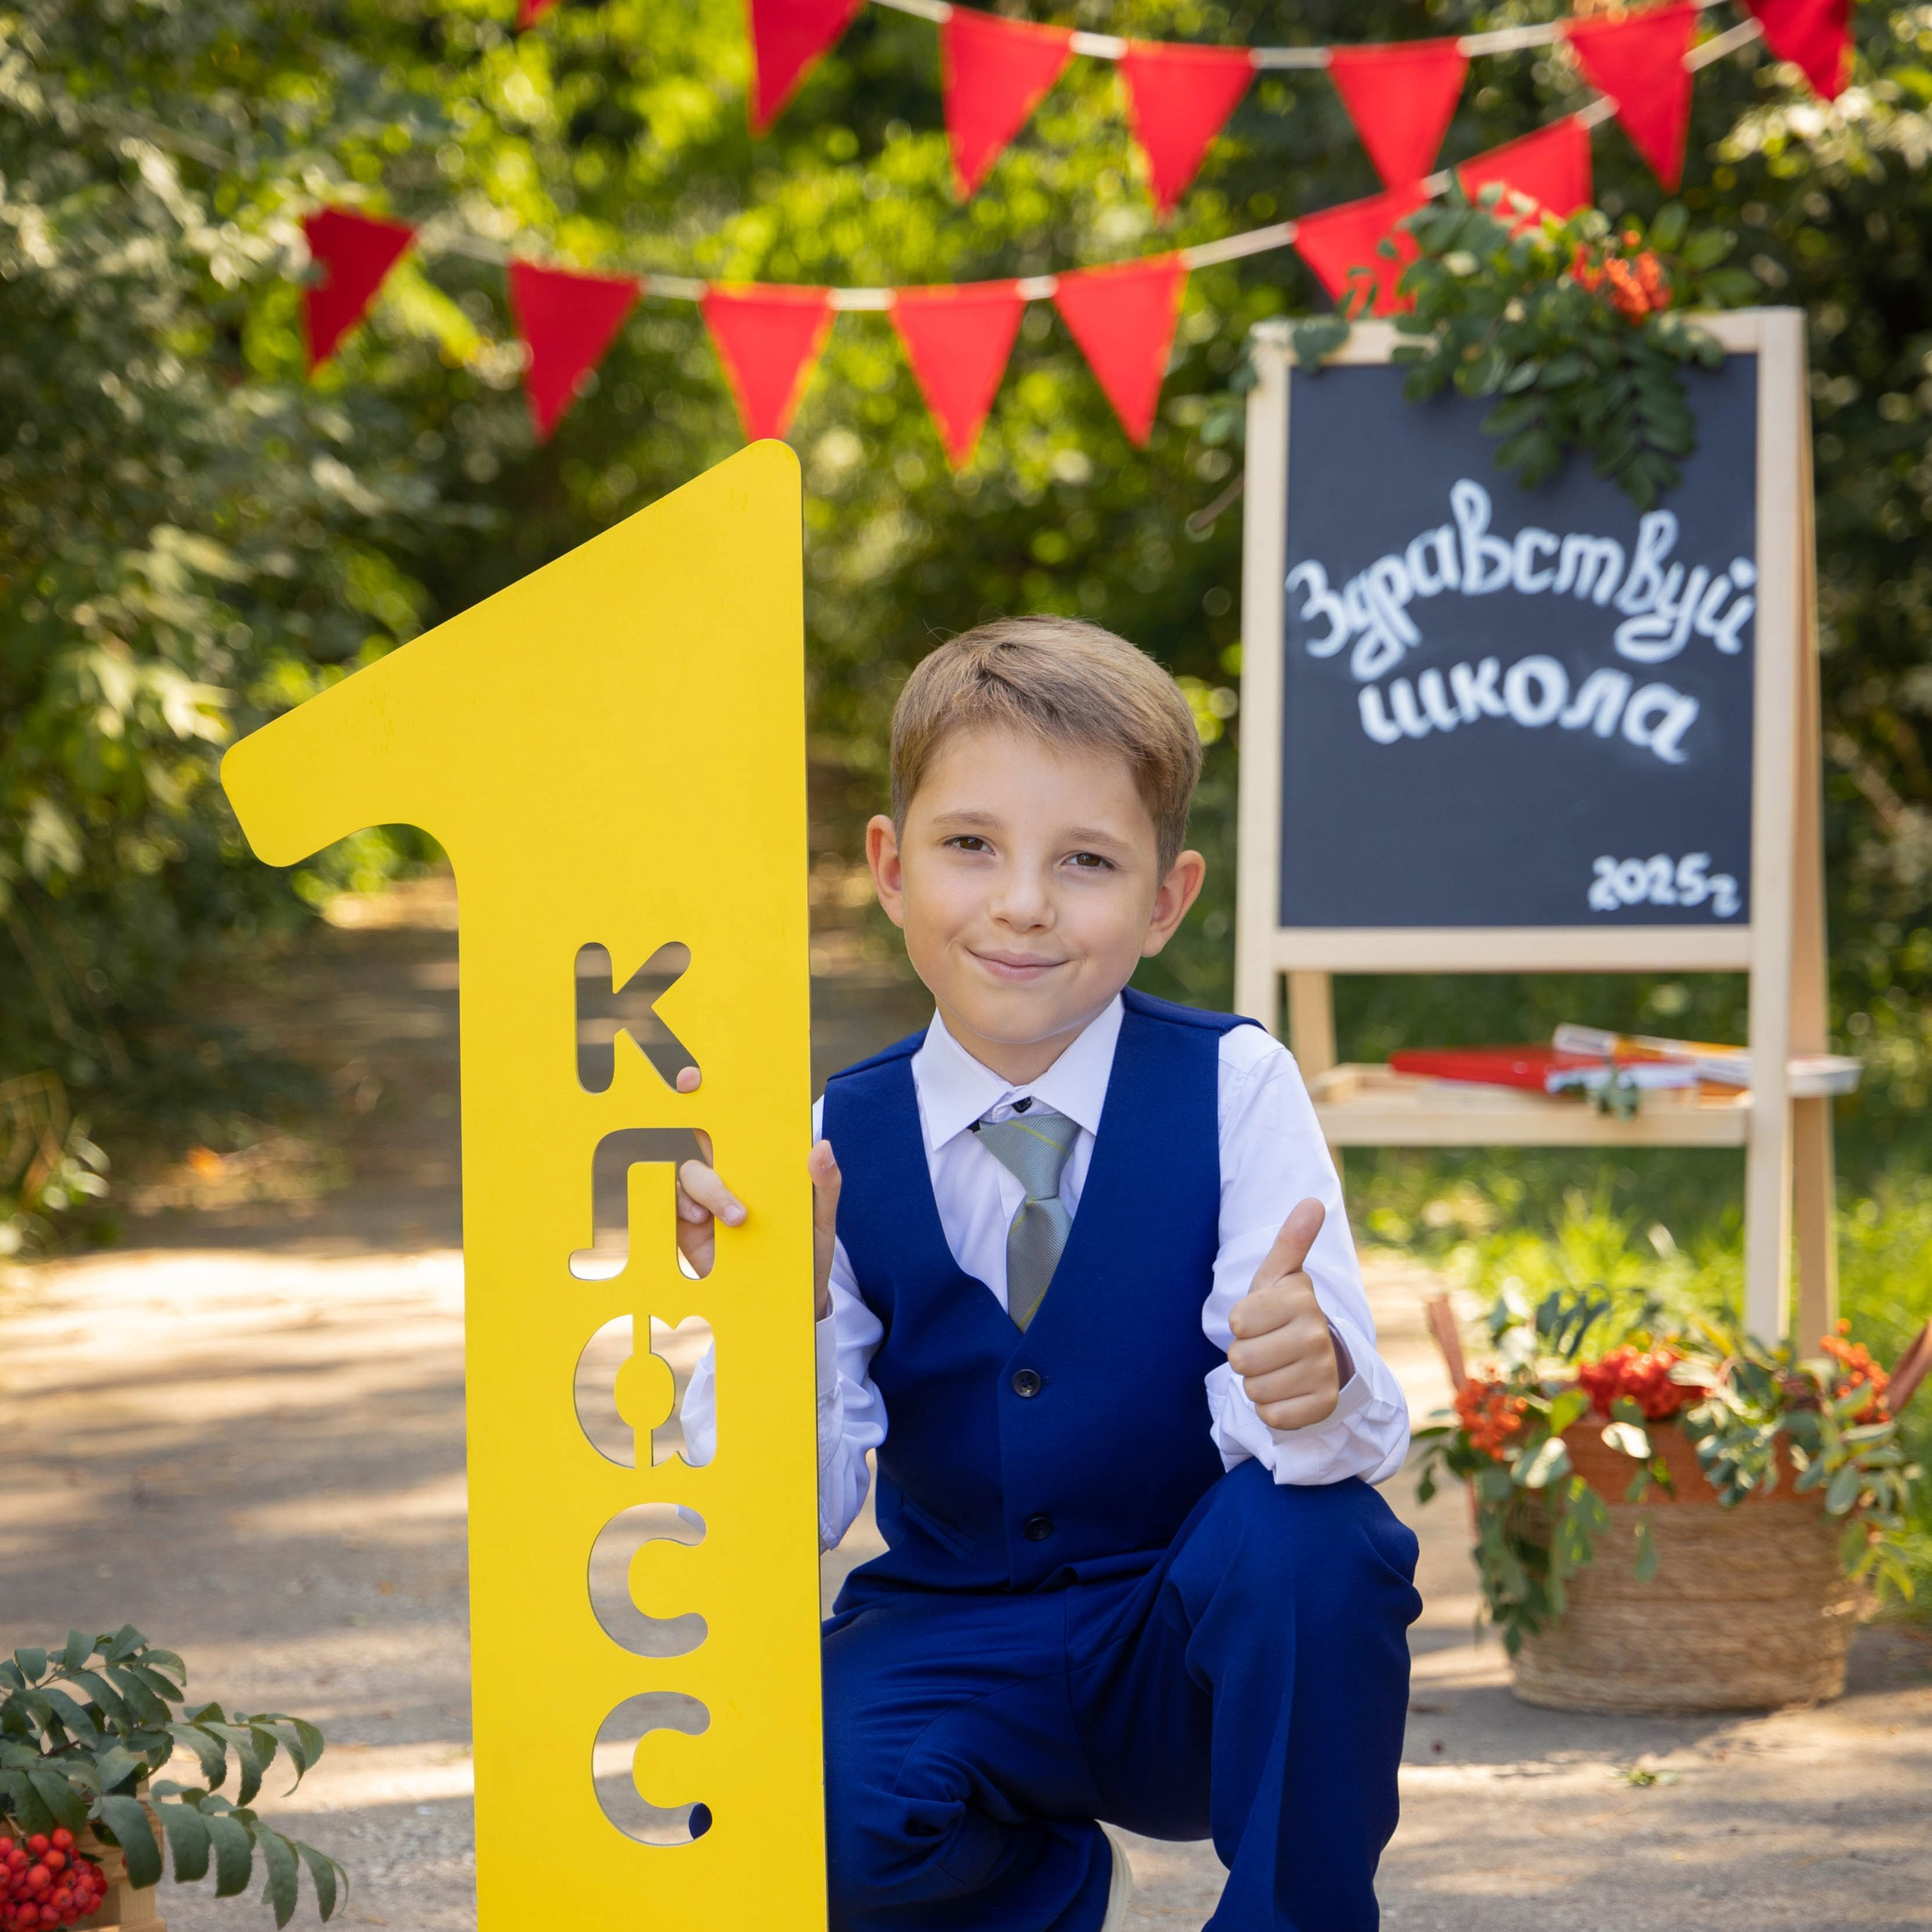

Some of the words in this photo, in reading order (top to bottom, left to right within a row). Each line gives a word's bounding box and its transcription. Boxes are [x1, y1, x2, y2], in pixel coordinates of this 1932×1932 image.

[1285, 478, 1755, 681] Здравствуй
[1358, 654, 1700, 764] школа
[220, 438, 829, 1932] 1
